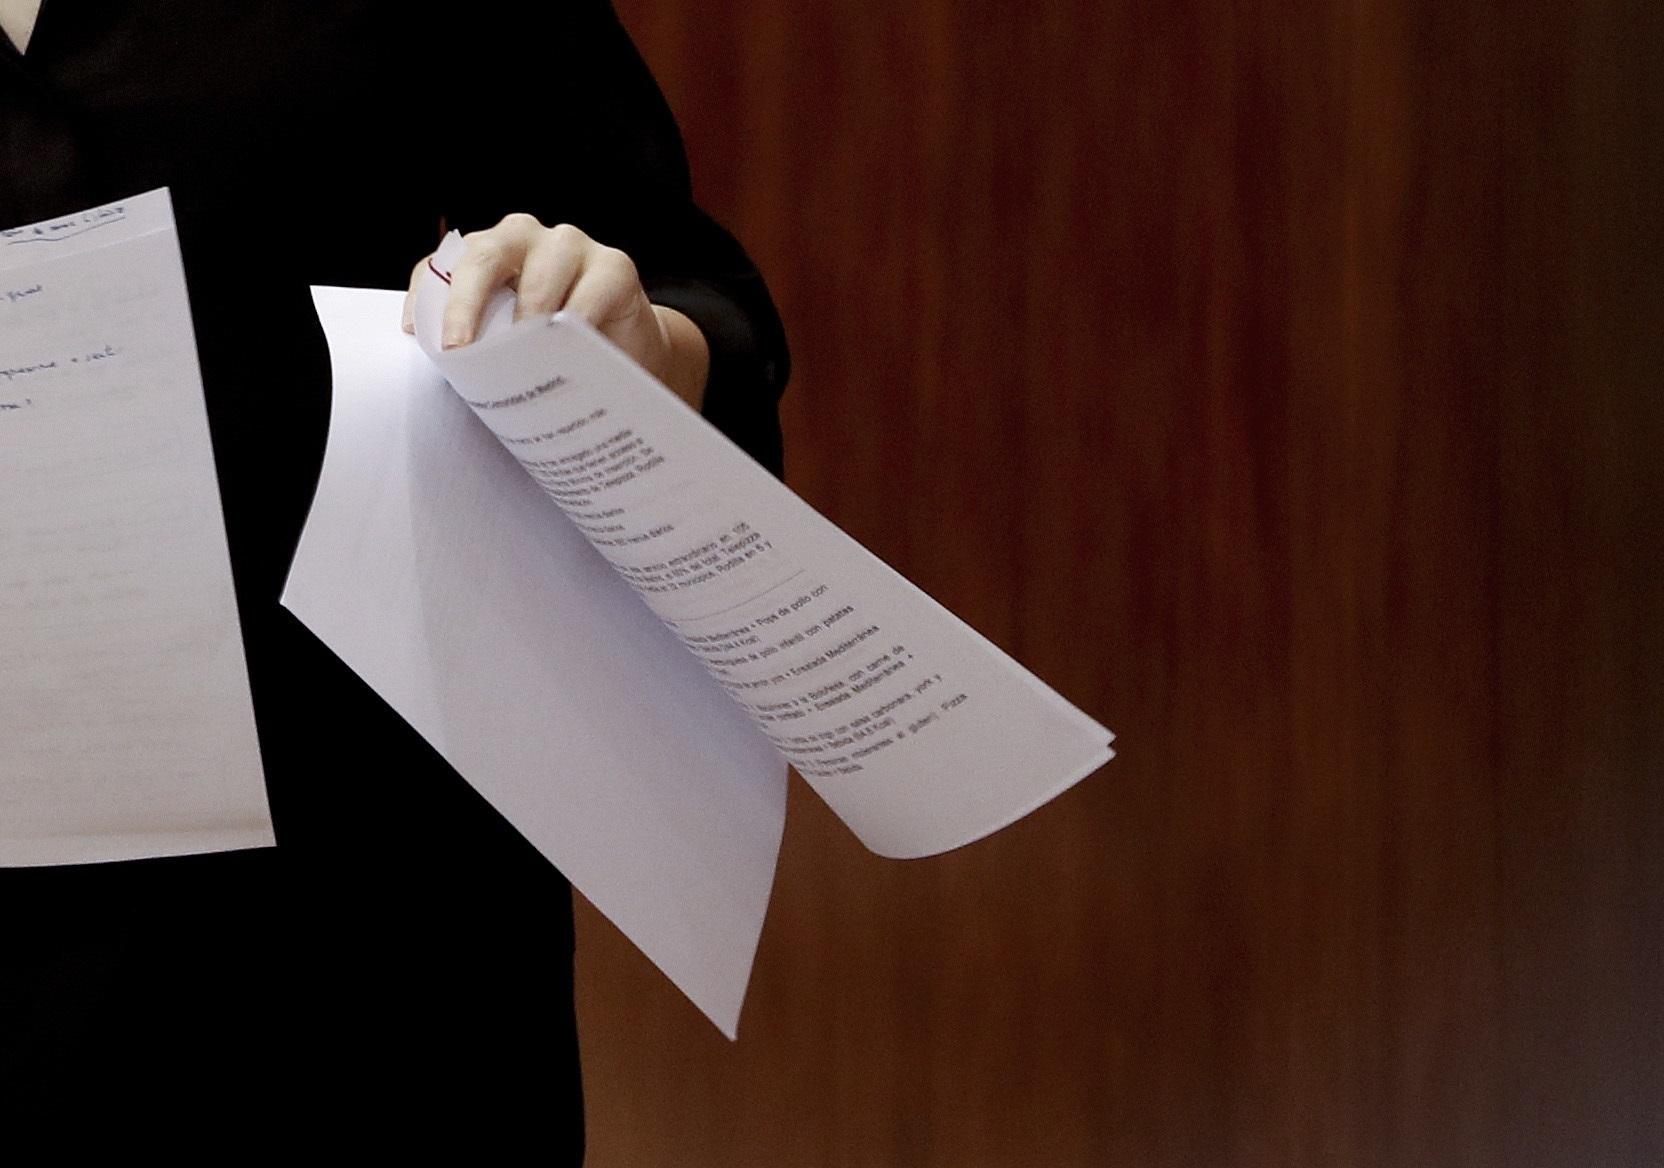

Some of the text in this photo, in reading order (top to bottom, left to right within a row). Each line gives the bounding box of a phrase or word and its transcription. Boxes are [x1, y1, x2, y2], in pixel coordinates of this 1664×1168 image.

[790, 595, 811, 610] pollo
[811, 585, 829, 598] con
[805, 624, 822, 636] con
[823, 606, 854, 627] patatas
[791, 656, 826, 675] Ensalada
[847, 669, 865, 682] con
[865, 654, 891, 671] carne
